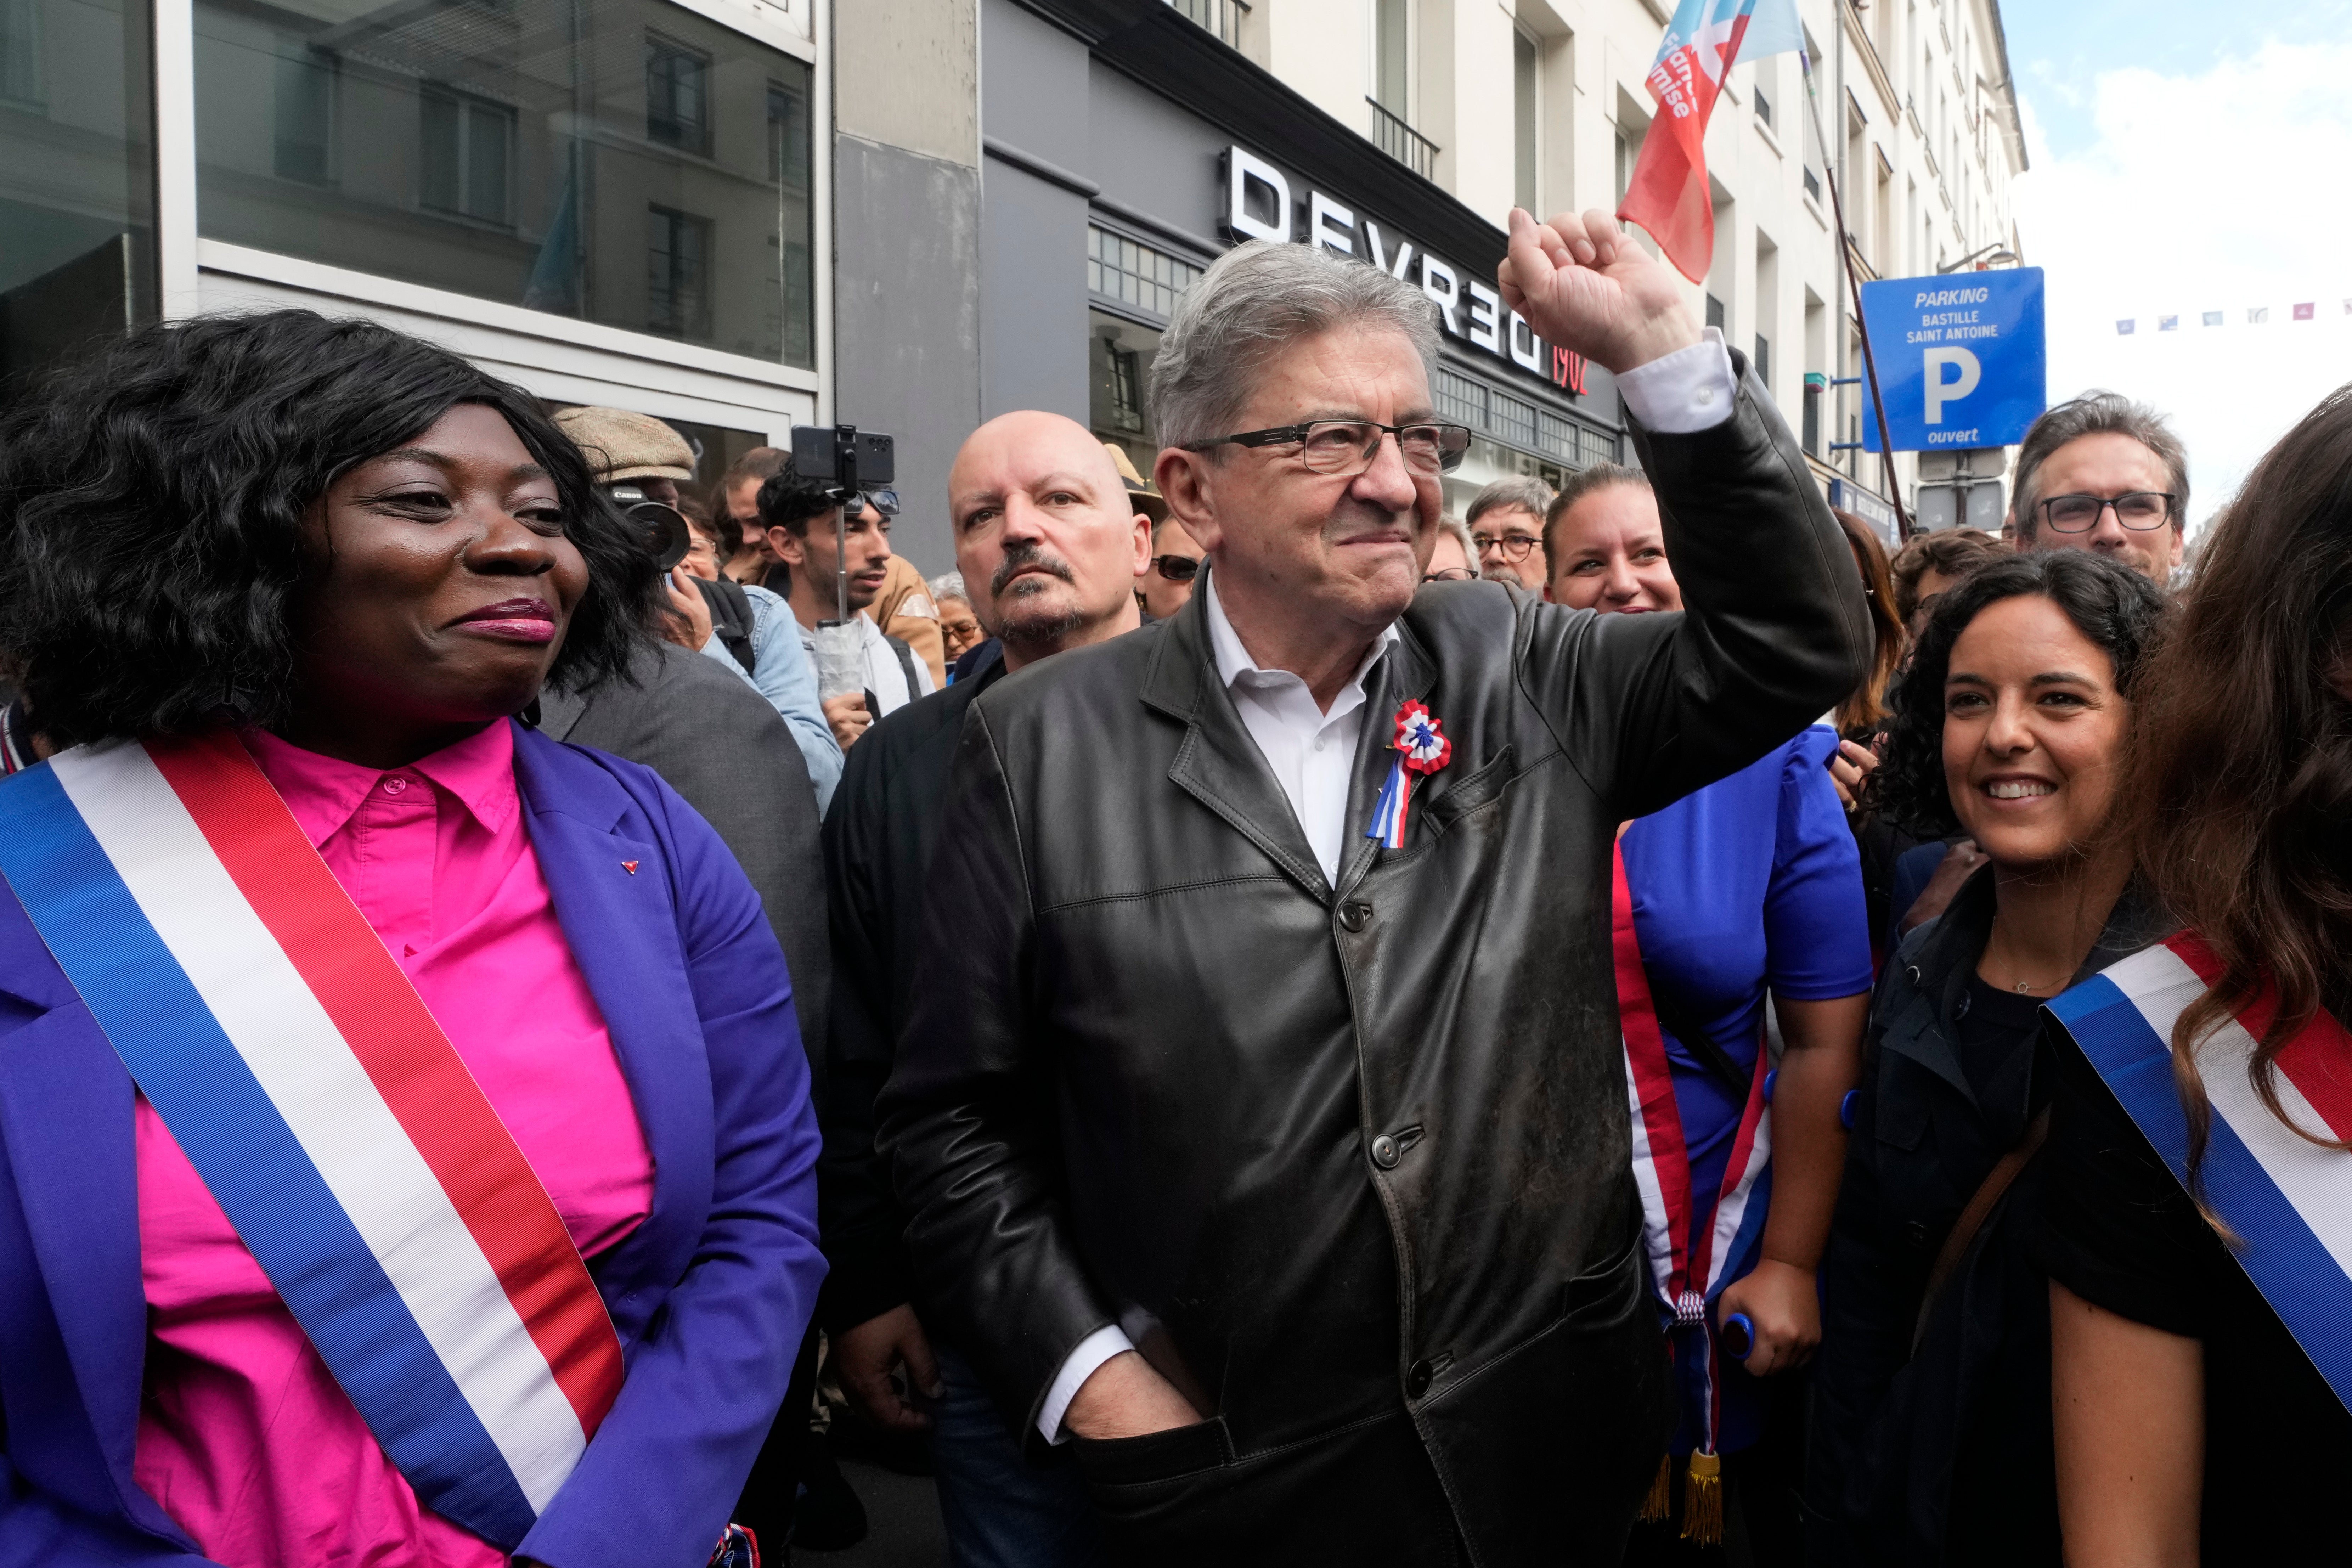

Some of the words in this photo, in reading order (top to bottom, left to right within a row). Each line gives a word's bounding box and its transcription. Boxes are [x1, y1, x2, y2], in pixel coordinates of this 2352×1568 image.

[1915, 287, 1988, 308] PARKING
[1923, 310, 1979, 327] BASTILLE
[1907, 329, 1942, 343] SAINT
[1946, 325, 1998, 340] ANTOINE
[1924, 346, 1981, 424] P
[1928, 428, 1978, 443] ouvert
